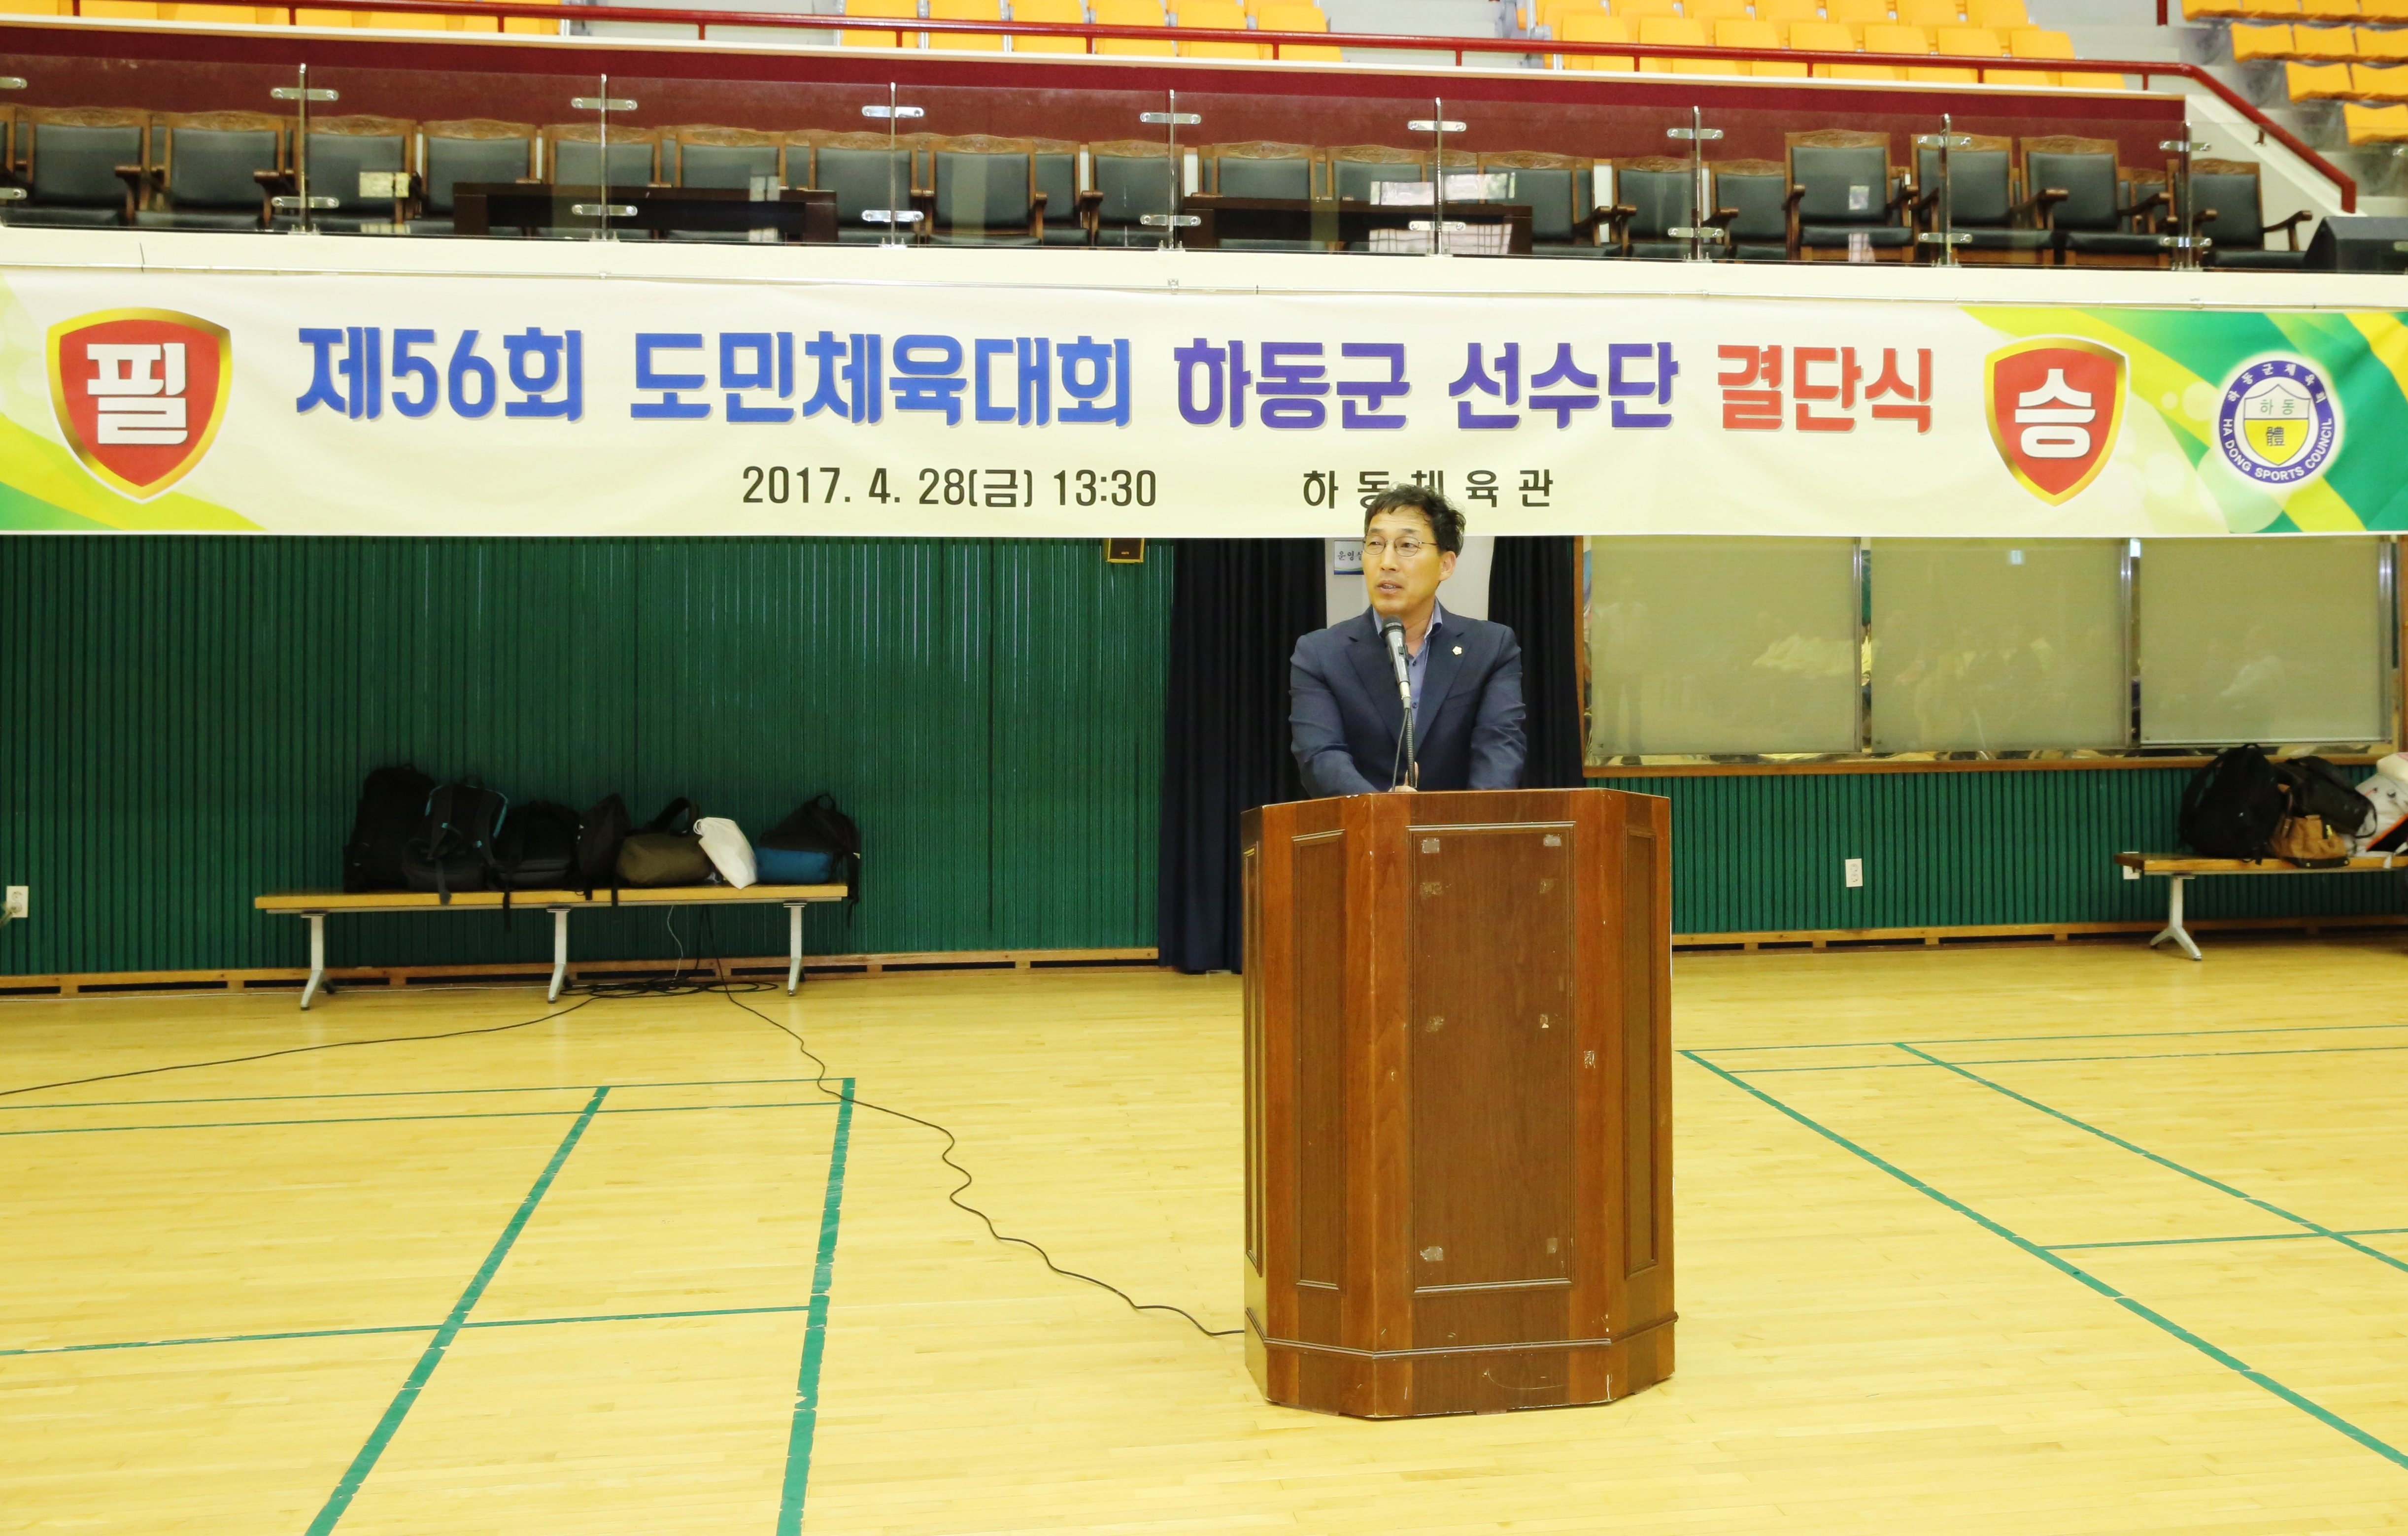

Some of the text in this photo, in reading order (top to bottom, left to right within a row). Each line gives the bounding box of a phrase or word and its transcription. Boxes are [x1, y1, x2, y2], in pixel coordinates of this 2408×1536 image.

[86, 343, 189, 445] 필
[297, 327, 1933, 433] 제56회 도민체육대회 하동군 선수단 결단식
[2015, 368, 2095, 458] 승
[743, 466, 851, 503] 2017.
[868, 468, 900, 503] 4.
[1053, 469, 1156, 506] 13:30
[2223, 418, 2332, 481] HA DONG SPORTS COUNCIL
